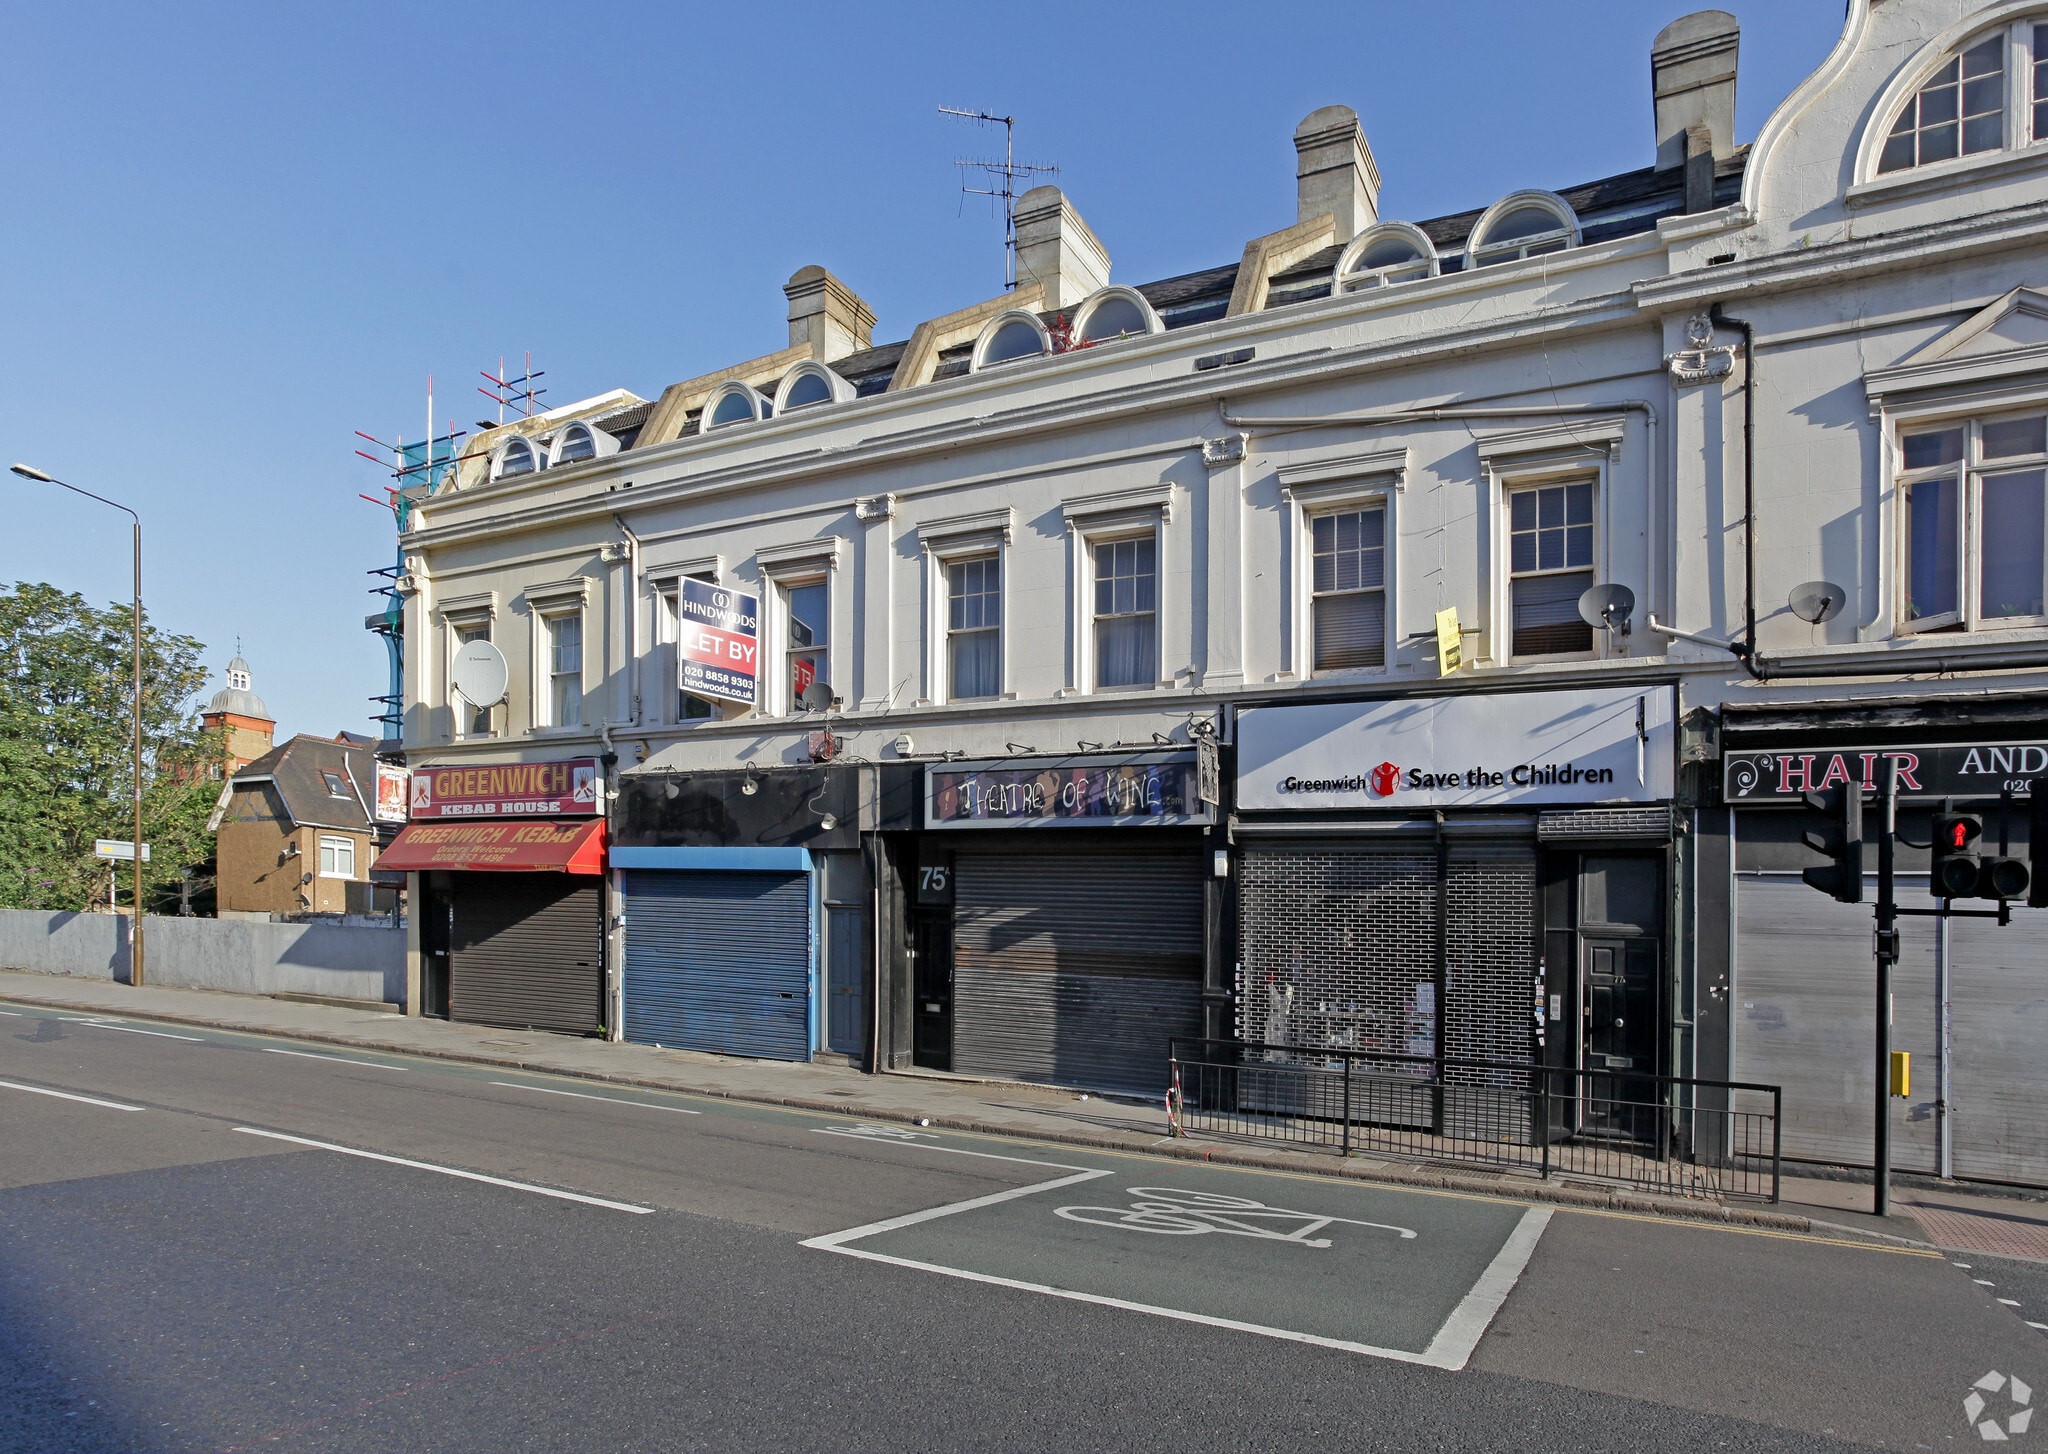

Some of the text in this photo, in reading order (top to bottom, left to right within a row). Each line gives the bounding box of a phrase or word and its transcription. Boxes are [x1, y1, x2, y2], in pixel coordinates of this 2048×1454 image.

[683, 600, 756, 629] HINDWOODS
[729, 640, 755, 663] BY
[684, 665, 754, 690] 020 8858 9303
[684, 676, 753, 700] hindwoods.co.uk
[435, 764, 568, 798] GREENWICH
[1285, 764, 1613, 791] Greenwich Save the Children
[1776, 746, 2048, 793] HAIR AND
[958, 771, 1161, 815] THEATRE OF WINE
[441, 801, 561, 815] KEBAB HOUSE
[405, 826, 583, 844] GREENWICH KEBAB
[471, 845, 517, 854] Welcome
